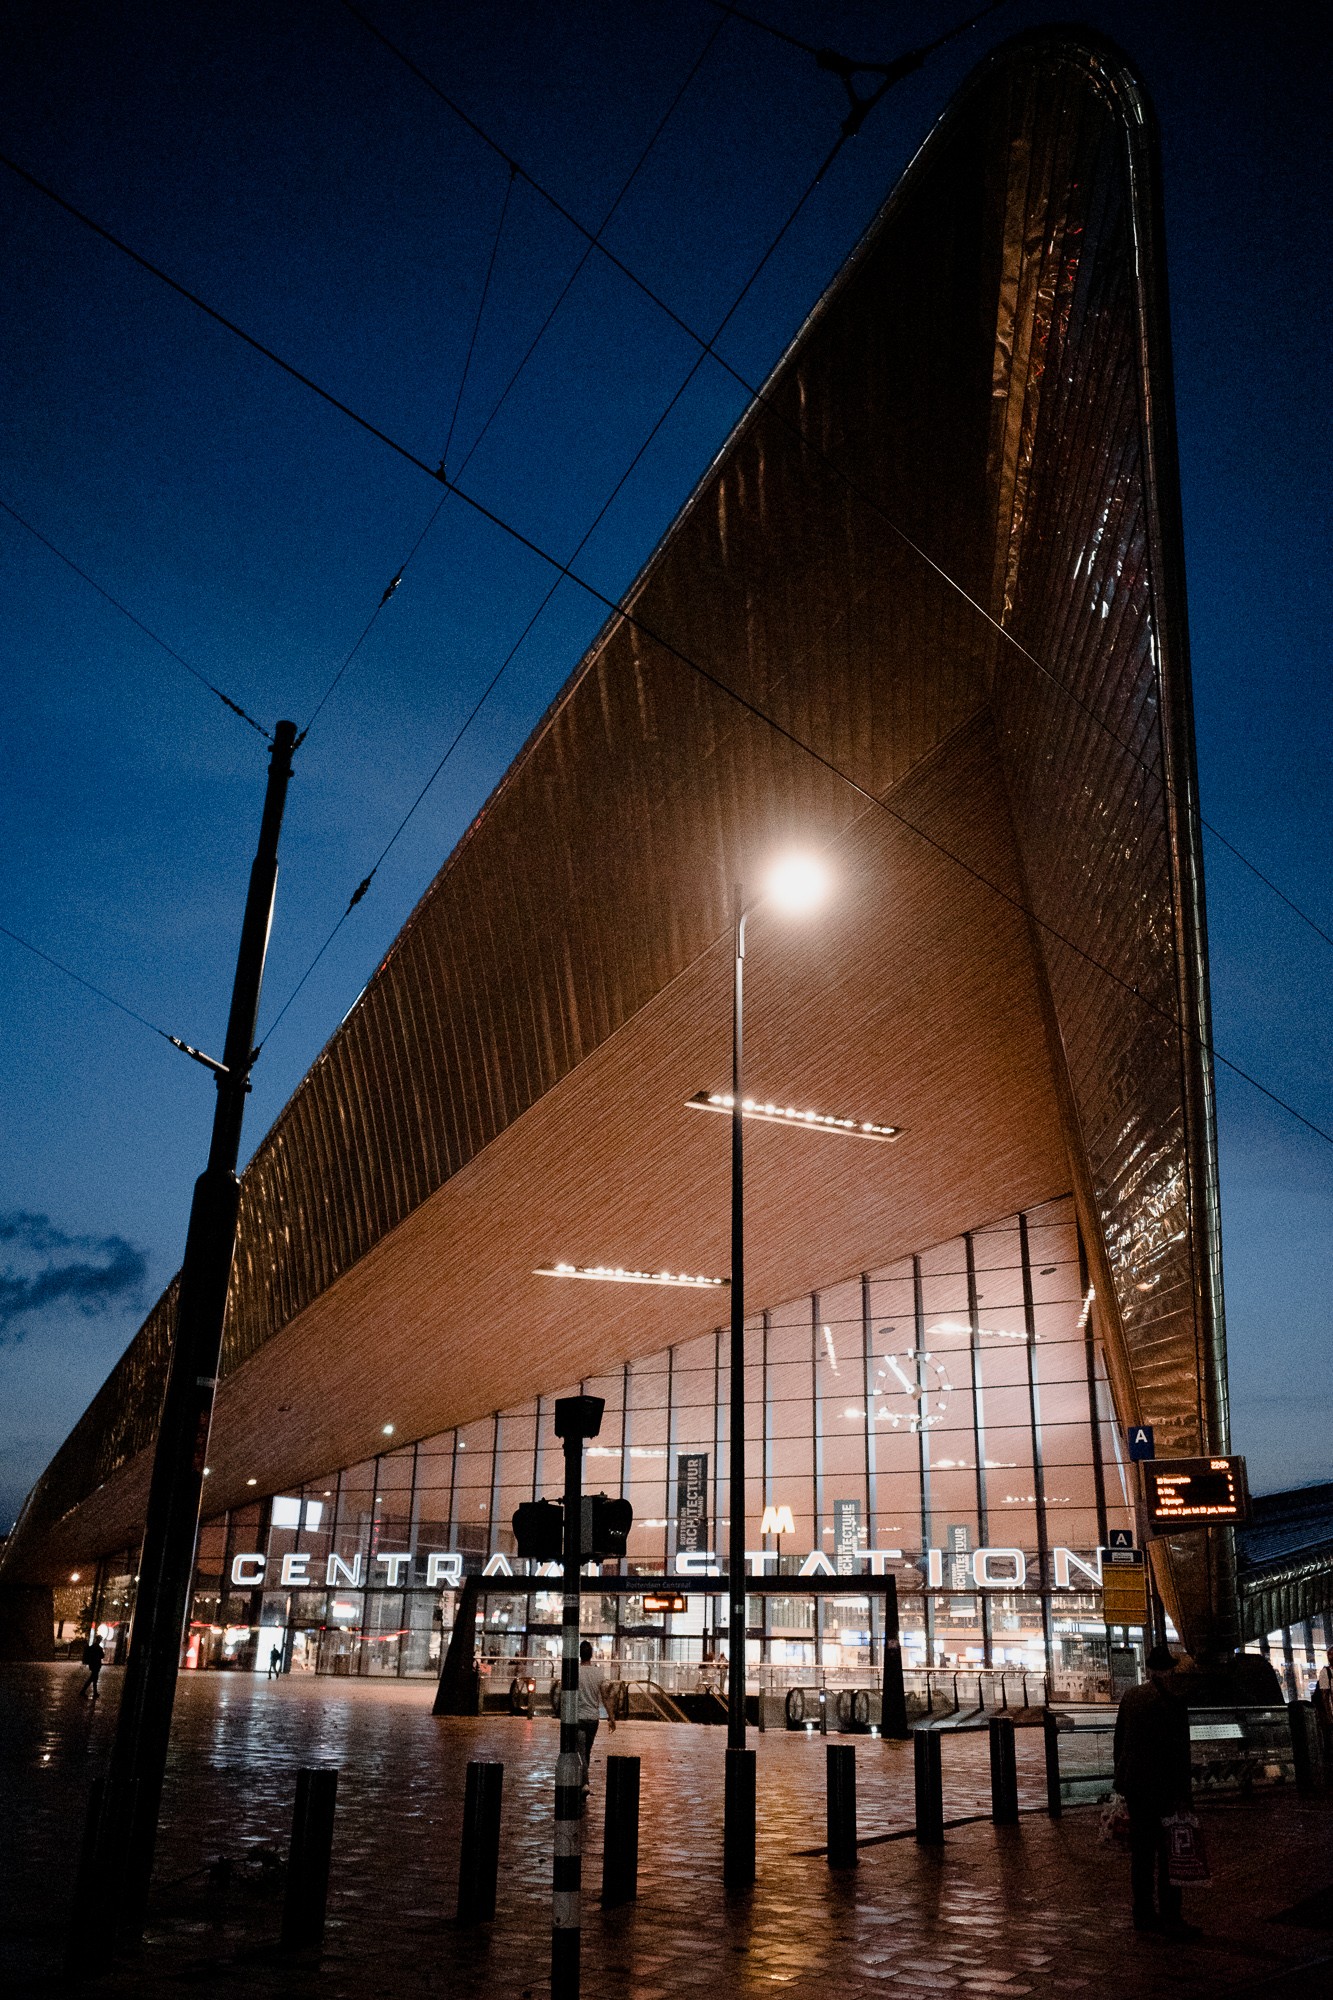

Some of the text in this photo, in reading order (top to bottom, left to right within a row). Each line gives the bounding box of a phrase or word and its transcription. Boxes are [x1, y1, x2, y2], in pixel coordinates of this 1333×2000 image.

[1135, 1429, 1148, 1444] A
[686, 1459, 699, 1553] ARCHITECTUUR
[760, 1506, 796, 1534] M
[842, 1504, 853, 1576] RCHITECTURE
[1115, 1533, 1128, 1546] A
[675, 1547, 1106, 1587] STATION
[955, 1528, 966, 1594] RCHITECTUUR
